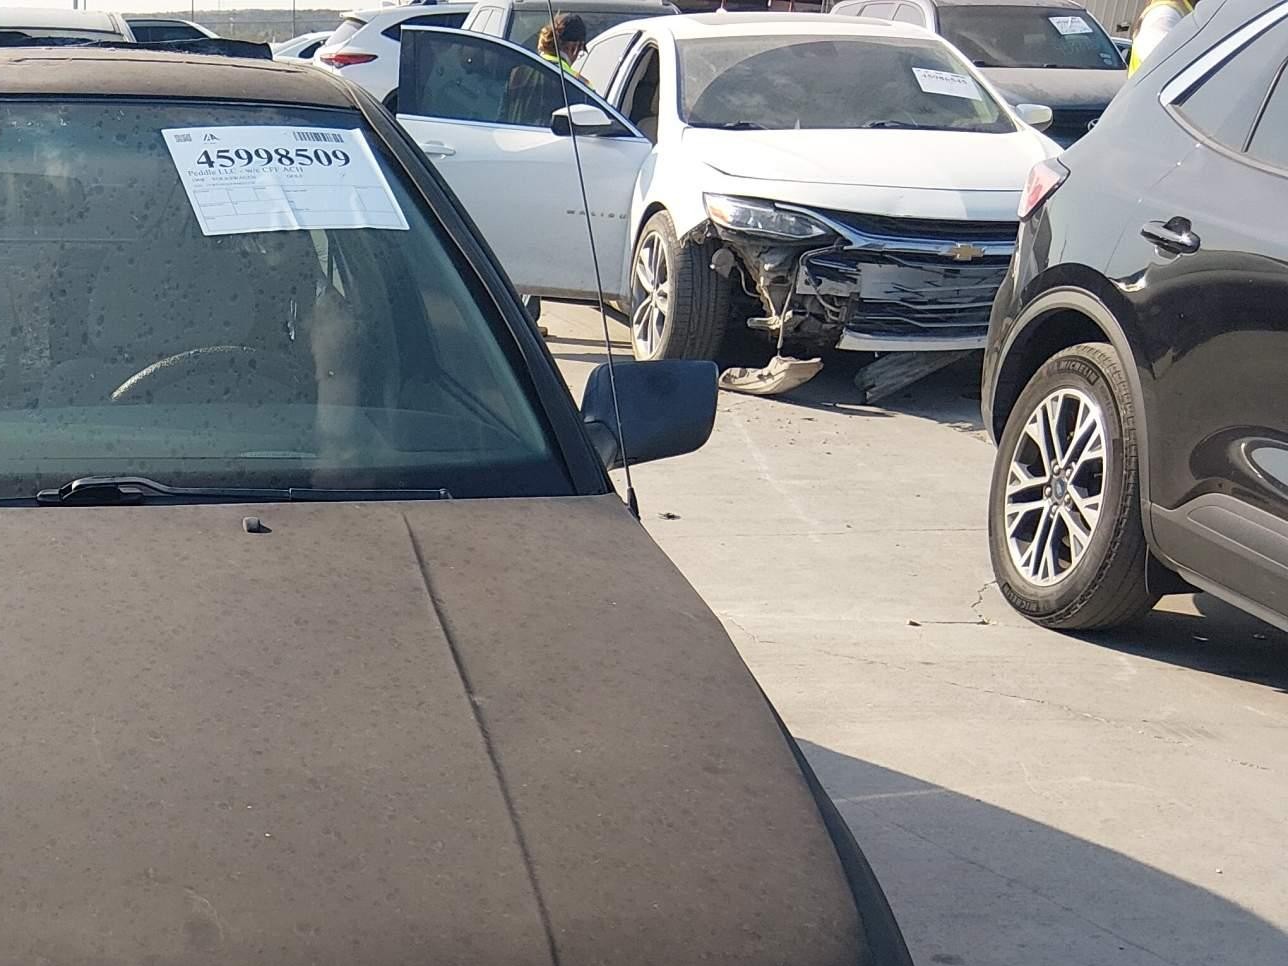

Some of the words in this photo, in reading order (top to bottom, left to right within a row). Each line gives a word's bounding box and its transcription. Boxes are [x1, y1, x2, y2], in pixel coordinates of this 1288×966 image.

[196, 147, 350, 168] 45998509
[566, 209, 627, 219] MALIBU
[1060, 360, 1099, 385] MICHELIN
